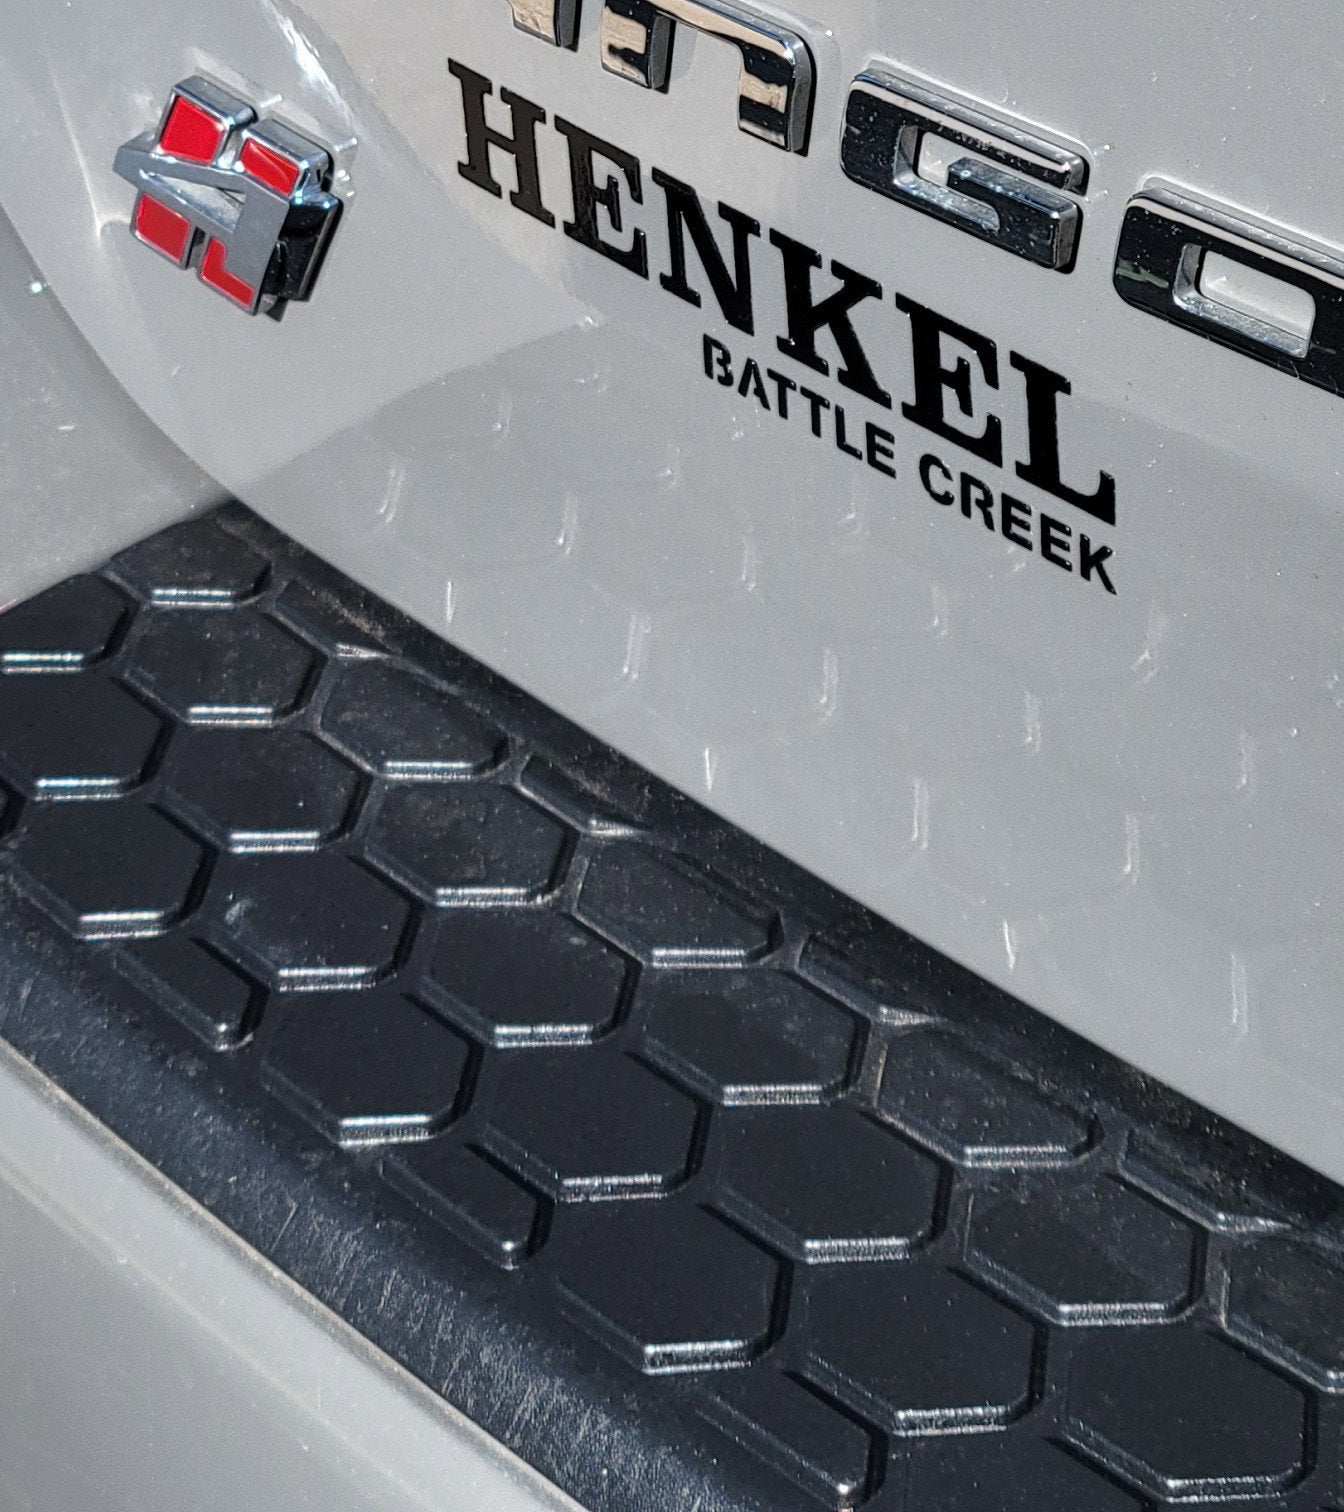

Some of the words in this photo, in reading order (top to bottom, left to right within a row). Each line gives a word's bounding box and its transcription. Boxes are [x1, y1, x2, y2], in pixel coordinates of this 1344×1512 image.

[447, 57, 1118, 527] HENKEL
[701, 333, 899, 479] BATTLE
[918, 452, 1119, 597] CREEK
